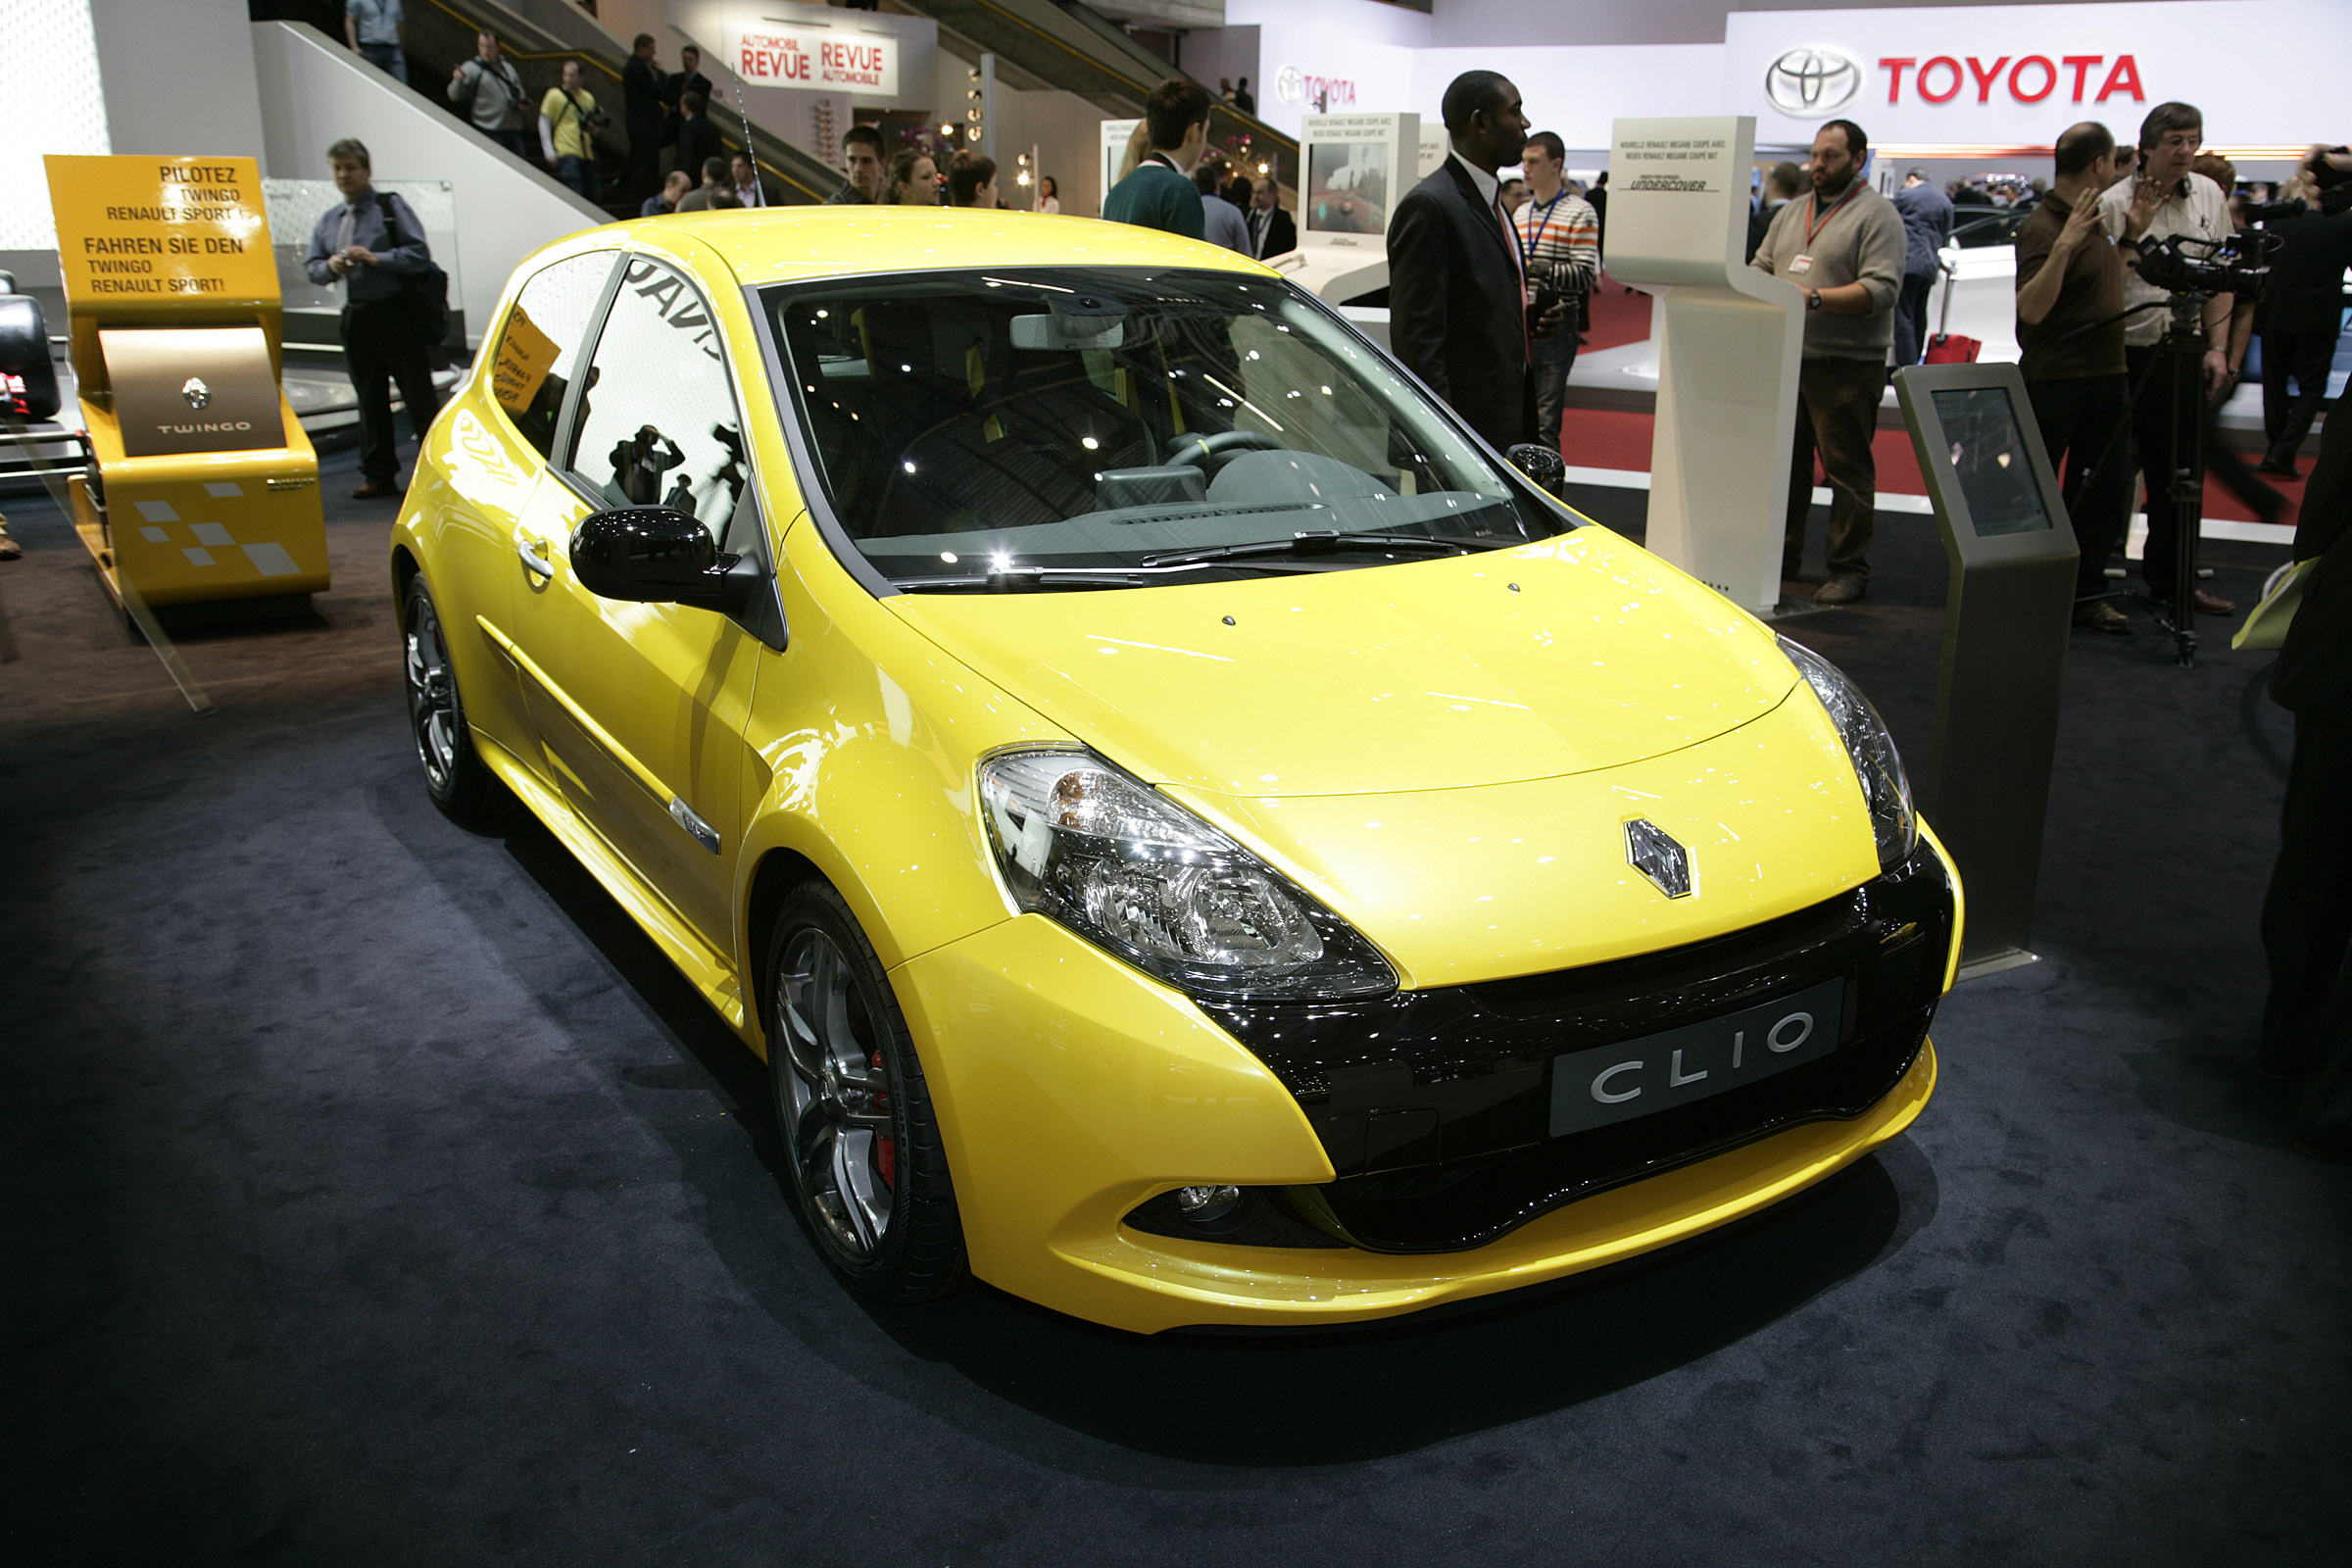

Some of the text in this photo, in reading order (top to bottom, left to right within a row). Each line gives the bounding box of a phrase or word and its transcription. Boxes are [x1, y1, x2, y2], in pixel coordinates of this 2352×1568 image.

[741, 33, 800, 51] AUTOMOBIL
[741, 49, 810, 79] REVUE
[821, 41, 883, 72] REVUE
[821, 70, 879, 85] AUTOMOBILE
[1879, 54, 2146, 104] TOYOTA
[1304, 75, 1355, 103] TOYOTA
[159, 166, 237, 183] PILOTEZ
[181, 188, 240, 202] TWINGO
[106, 206, 177, 220] RENAULT
[182, 207, 232, 220] SPORT
[83, 237, 244, 255] FAHREN SIE DEN
[86, 260, 153, 273] TWINGO
[90, 278, 226, 293] RENAULT SPORT!
[157, 421, 252, 434] TWINGO
[1591, 1011, 1814, 1103] CLIO
